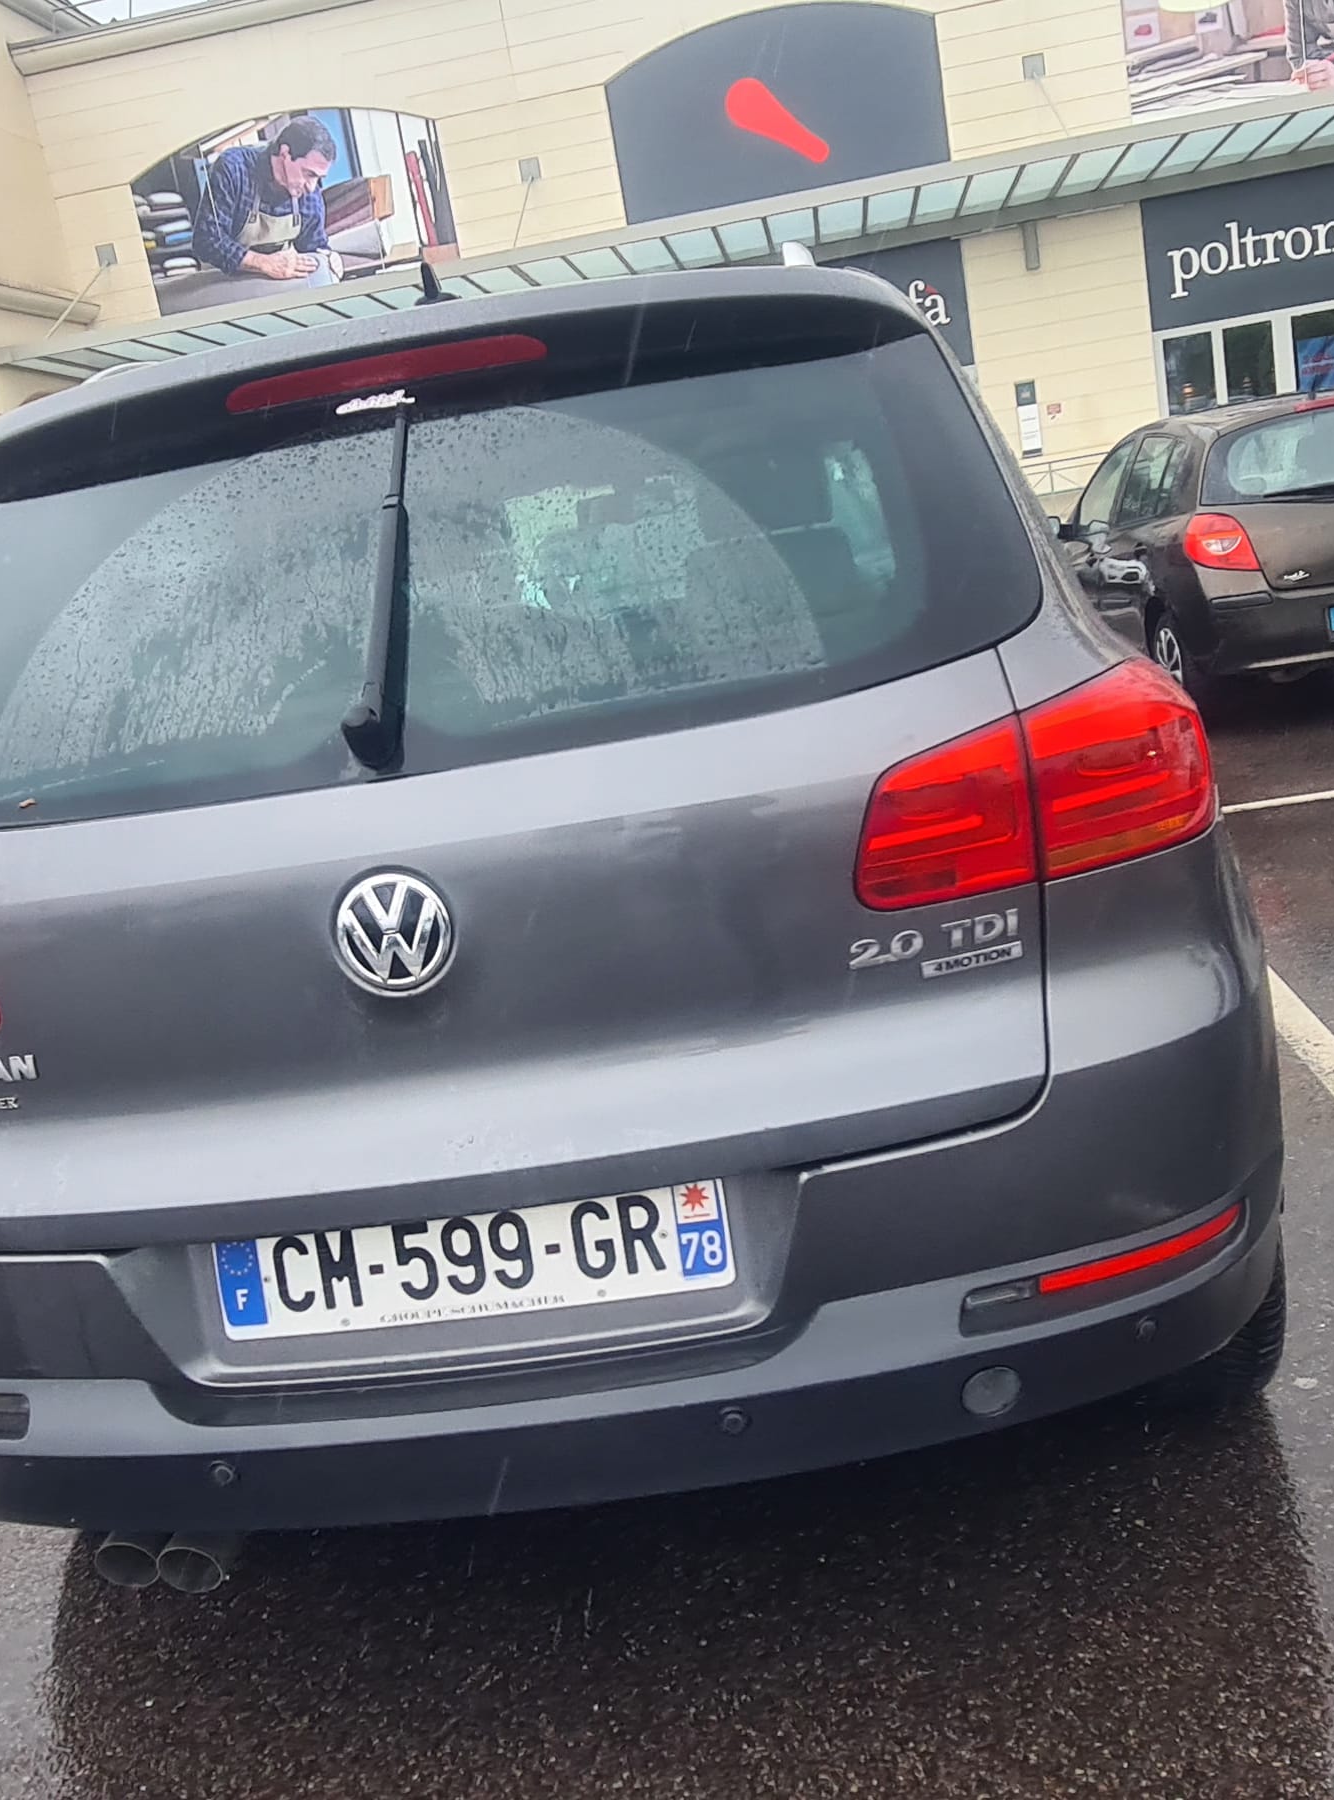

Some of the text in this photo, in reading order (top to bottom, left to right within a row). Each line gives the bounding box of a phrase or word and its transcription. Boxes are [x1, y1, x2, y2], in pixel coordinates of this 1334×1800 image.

[849, 907, 1019, 970] 2.0 TDI
[932, 947, 1013, 973] 4MOTION
[271, 1193, 667, 1313] CM-599-GR
[680, 1229, 724, 1271] 78
[235, 1288, 249, 1311] F
